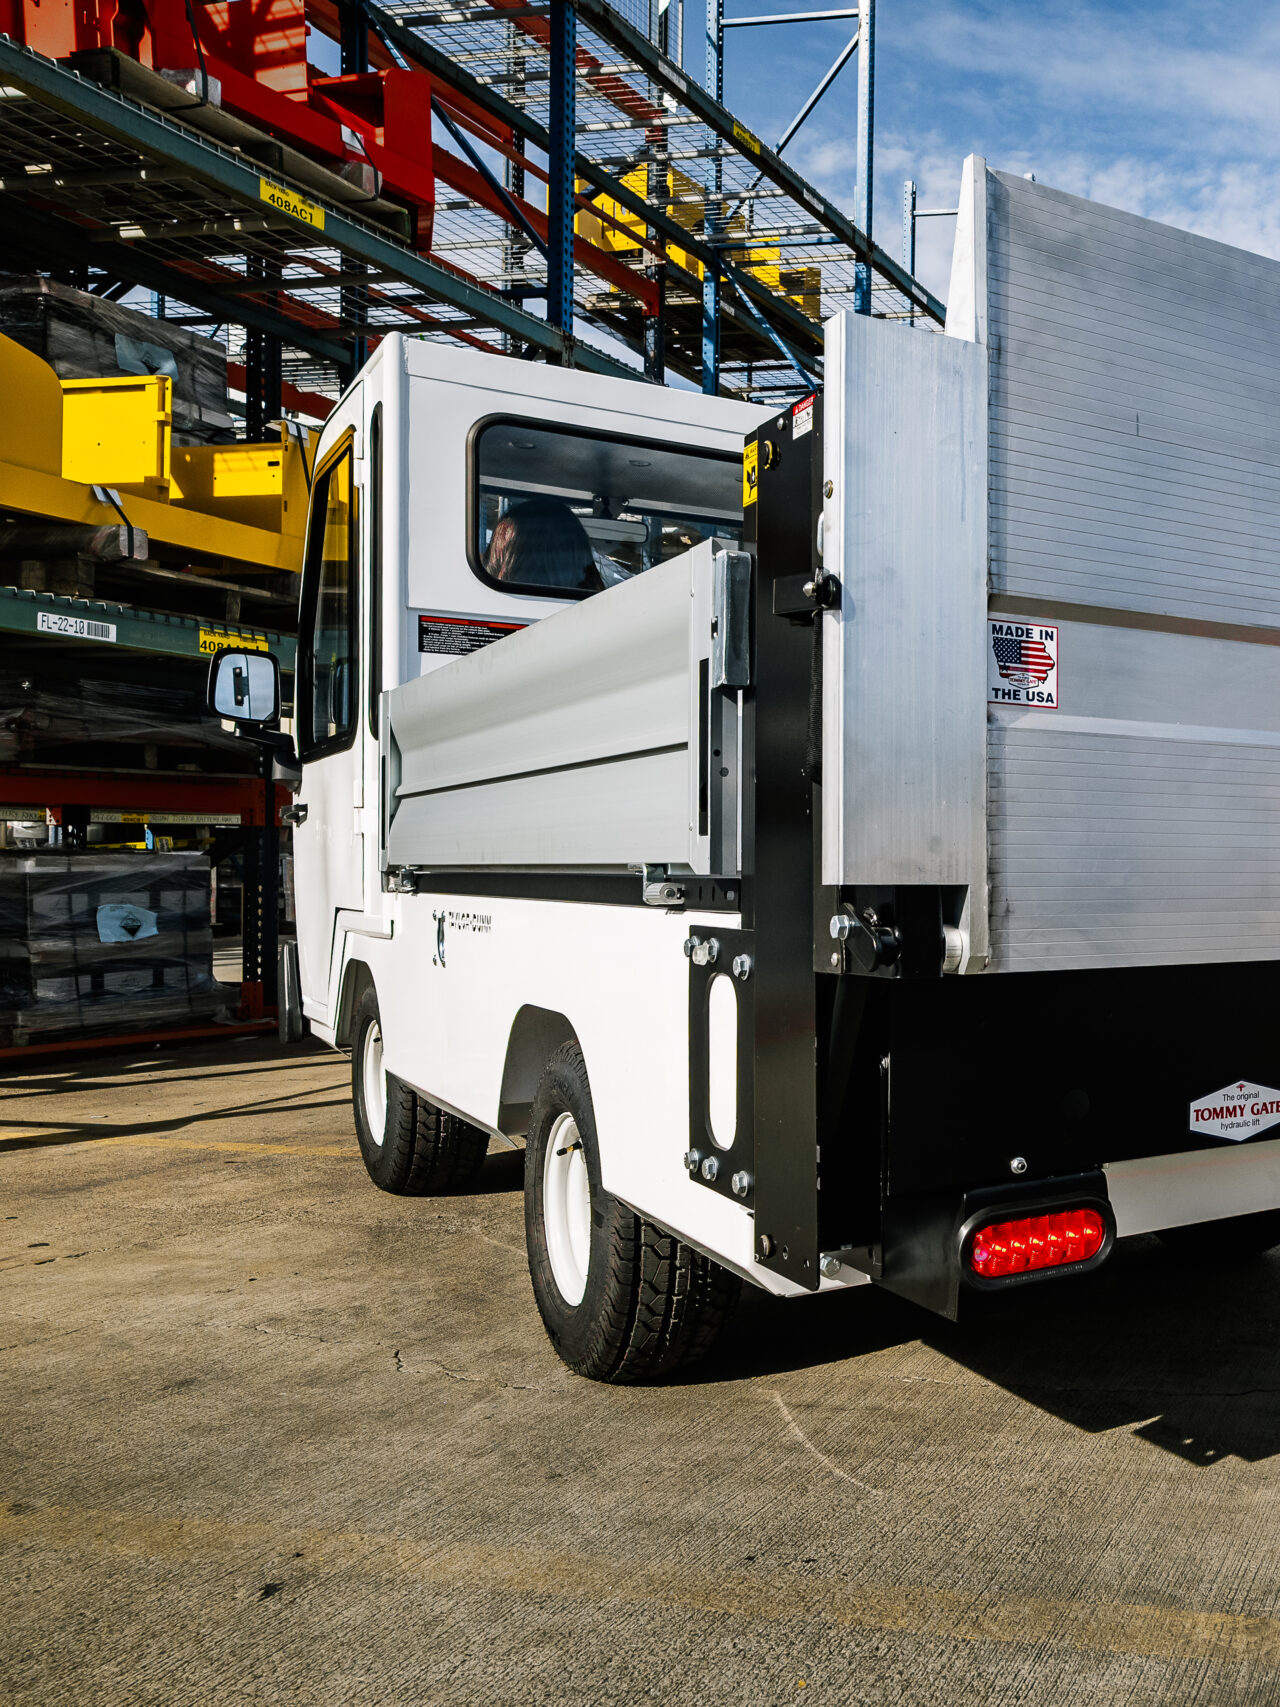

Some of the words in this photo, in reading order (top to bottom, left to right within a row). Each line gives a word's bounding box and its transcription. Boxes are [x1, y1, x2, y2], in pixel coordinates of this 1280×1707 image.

[268, 193, 313, 223] 408AC1
[41, 614, 84, 634] FL-22-10
[991, 623, 1034, 639] MADE
[1039, 629, 1054, 641] IN
[991, 687, 1021, 701] THE
[1026, 690, 1054, 704] USA
[1222, 1093, 1235, 1102] The
[1236, 1091, 1260, 1102] original
[1193, 1104, 1246, 1122] TOMMY
[1220, 1120, 1251, 1131] hydraulic
[1251, 1118, 1260, 1126] lift
